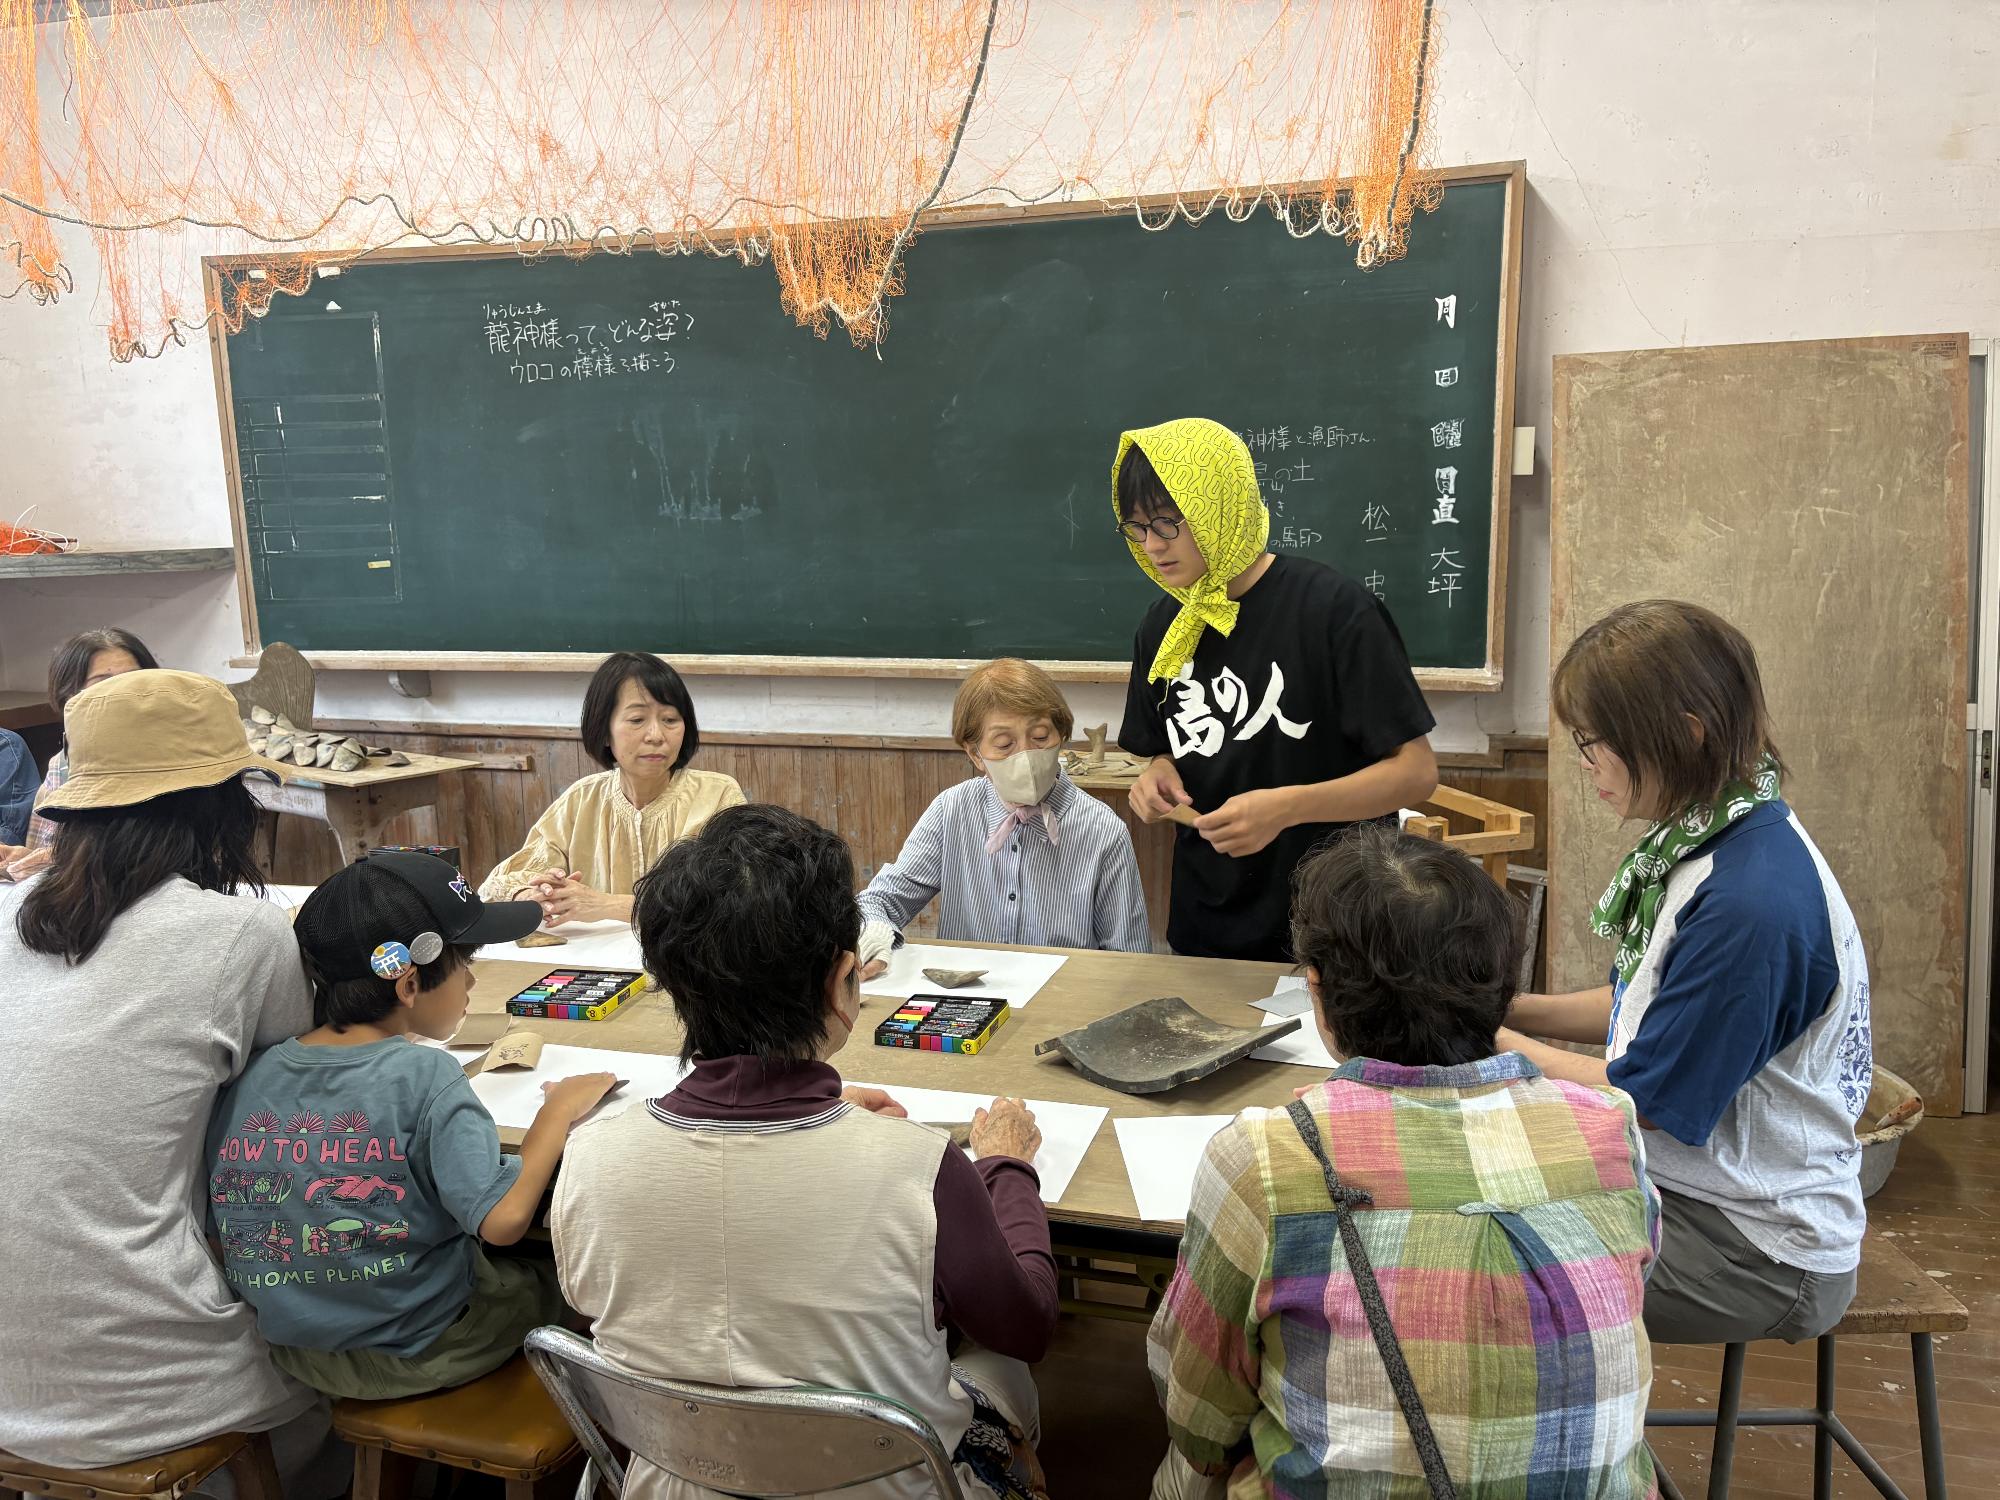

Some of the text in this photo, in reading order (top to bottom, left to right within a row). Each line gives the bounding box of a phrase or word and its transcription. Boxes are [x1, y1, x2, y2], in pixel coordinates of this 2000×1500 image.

[1234, 425, 1371, 453] 神様と漁師さん
[1165, 660, 1313, 760] 島の人
[273, 1137, 309, 1164] TO
[319, 1136, 407, 1164] HEAL
[247, 1270, 317, 1289] HOME
[326, 1251, 409, 1284] PLANET
